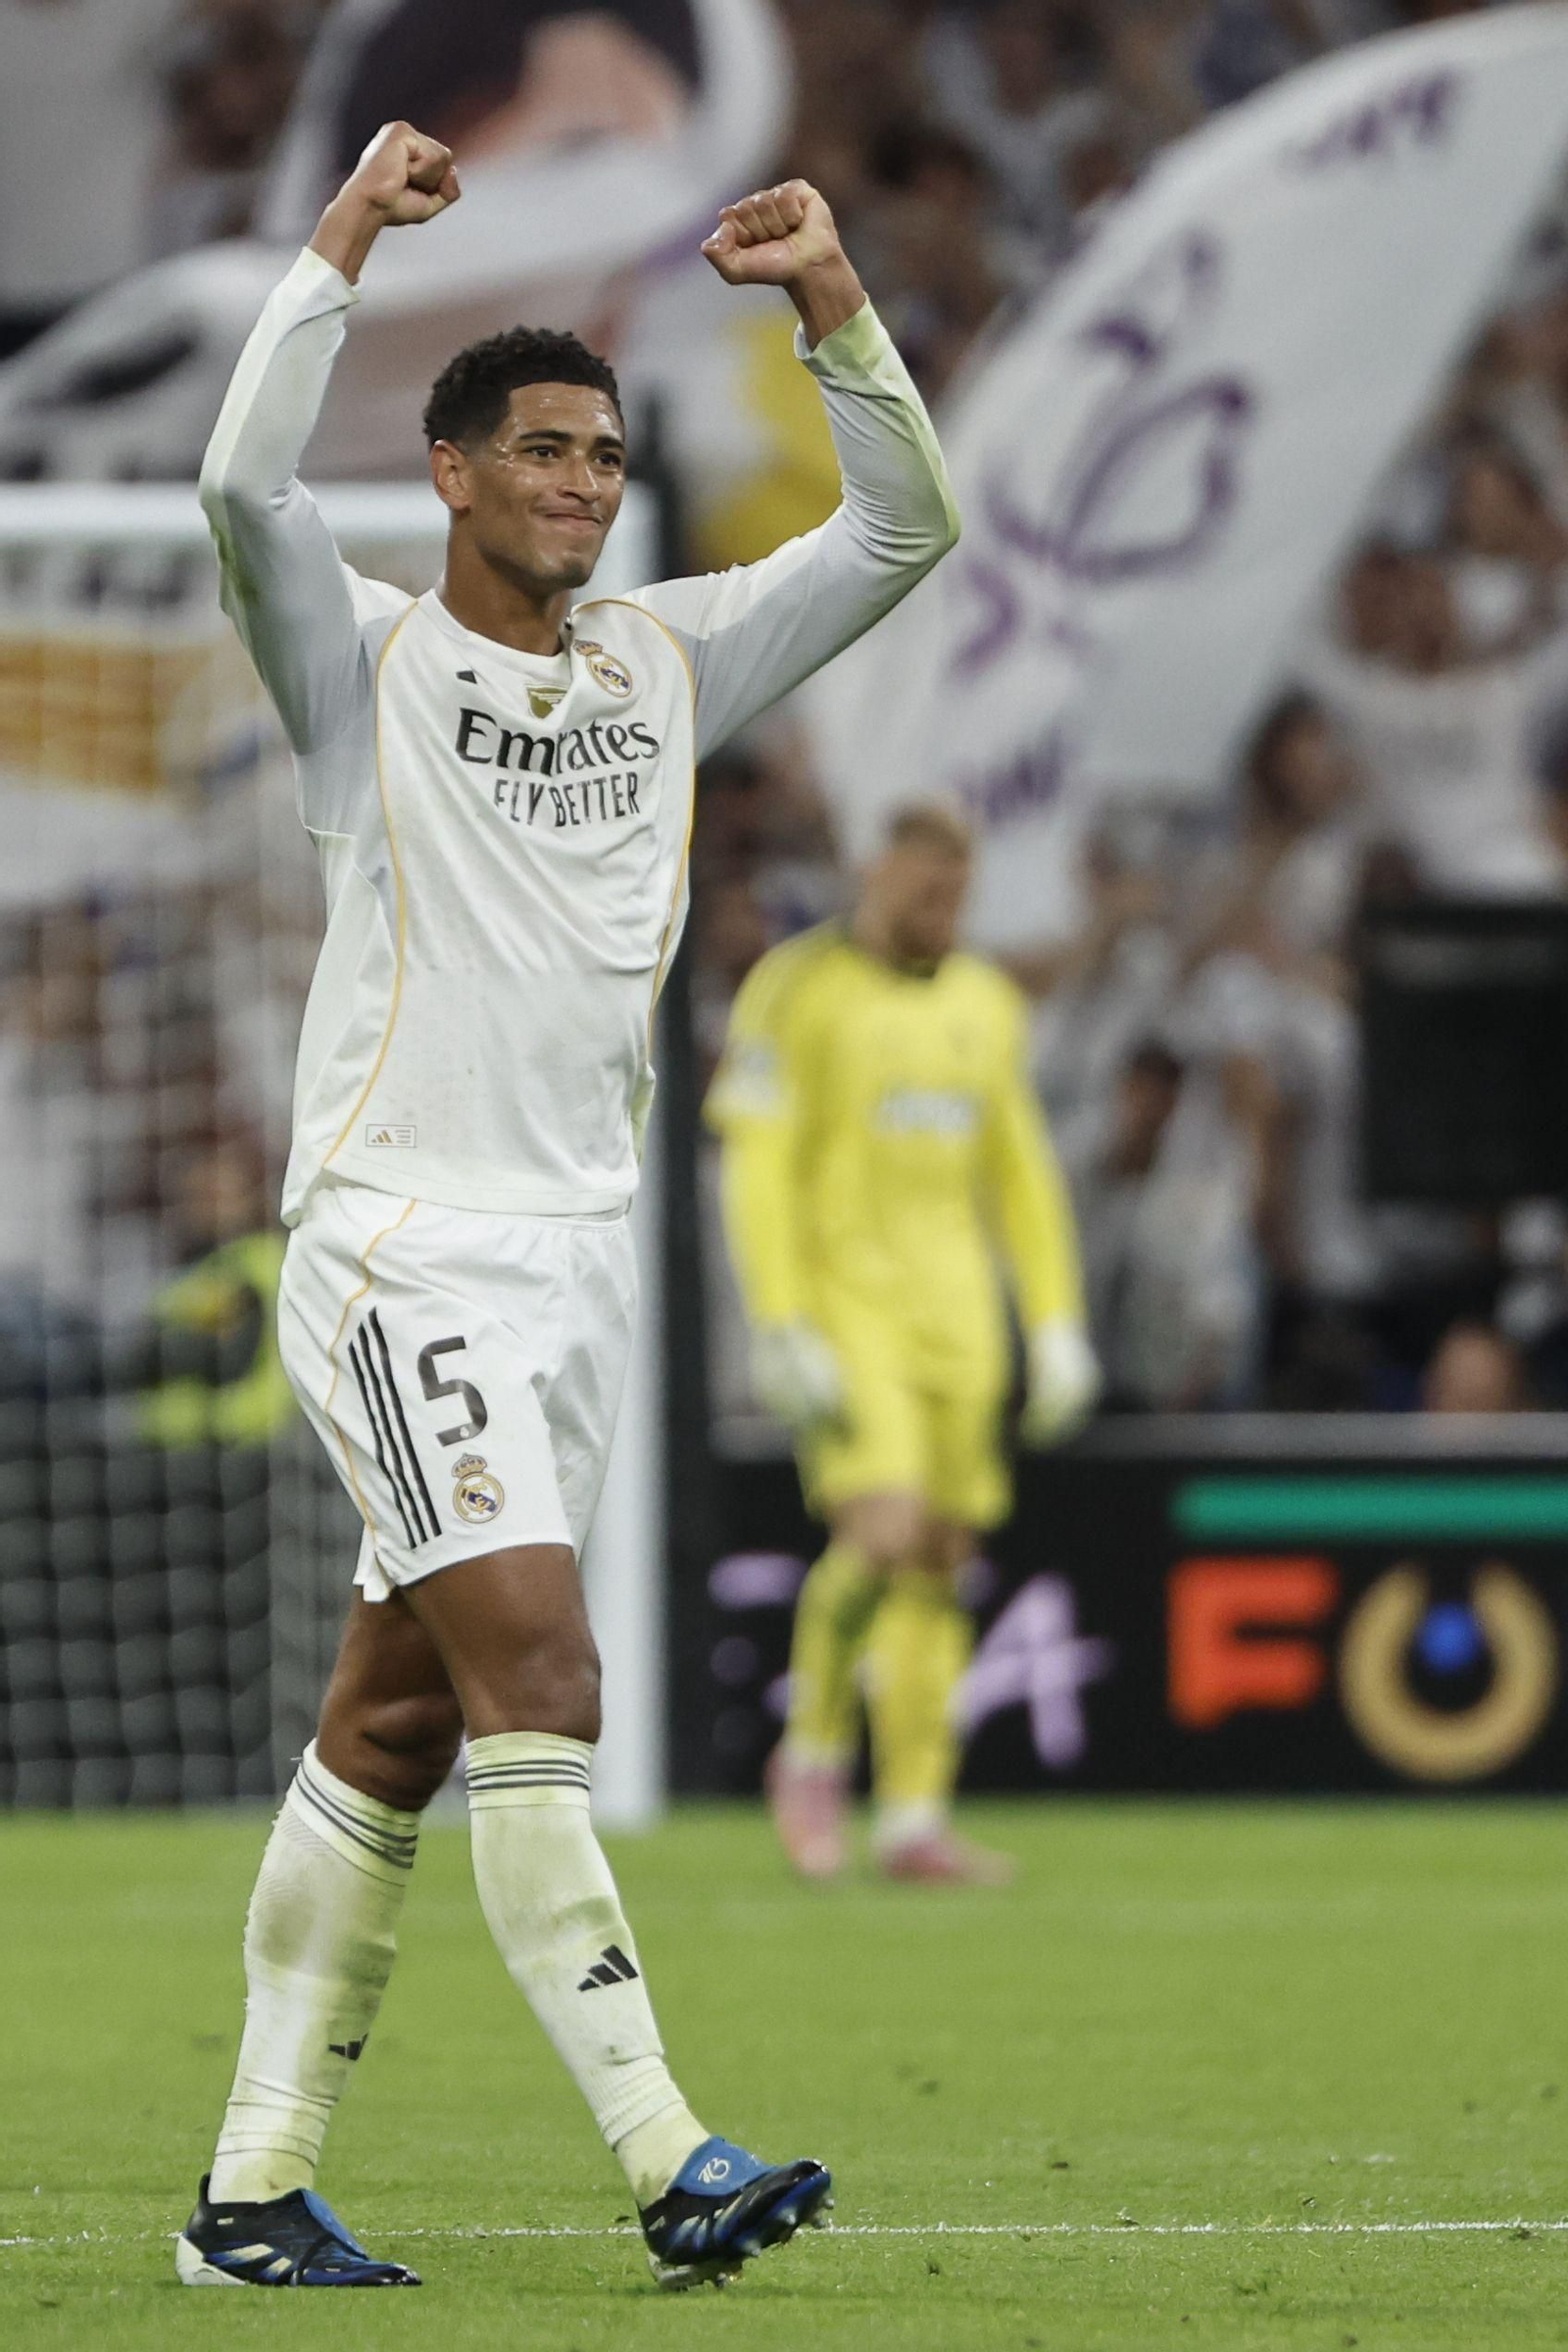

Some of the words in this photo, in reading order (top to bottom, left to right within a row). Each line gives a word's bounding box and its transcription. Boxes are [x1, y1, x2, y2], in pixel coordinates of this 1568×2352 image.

[455, 707, 660, 777] Emrates
[493, 778, 545, 826] FLY
[548, 771, 640, 827] BETTER
[416, 1335, 488, 1447] 5
